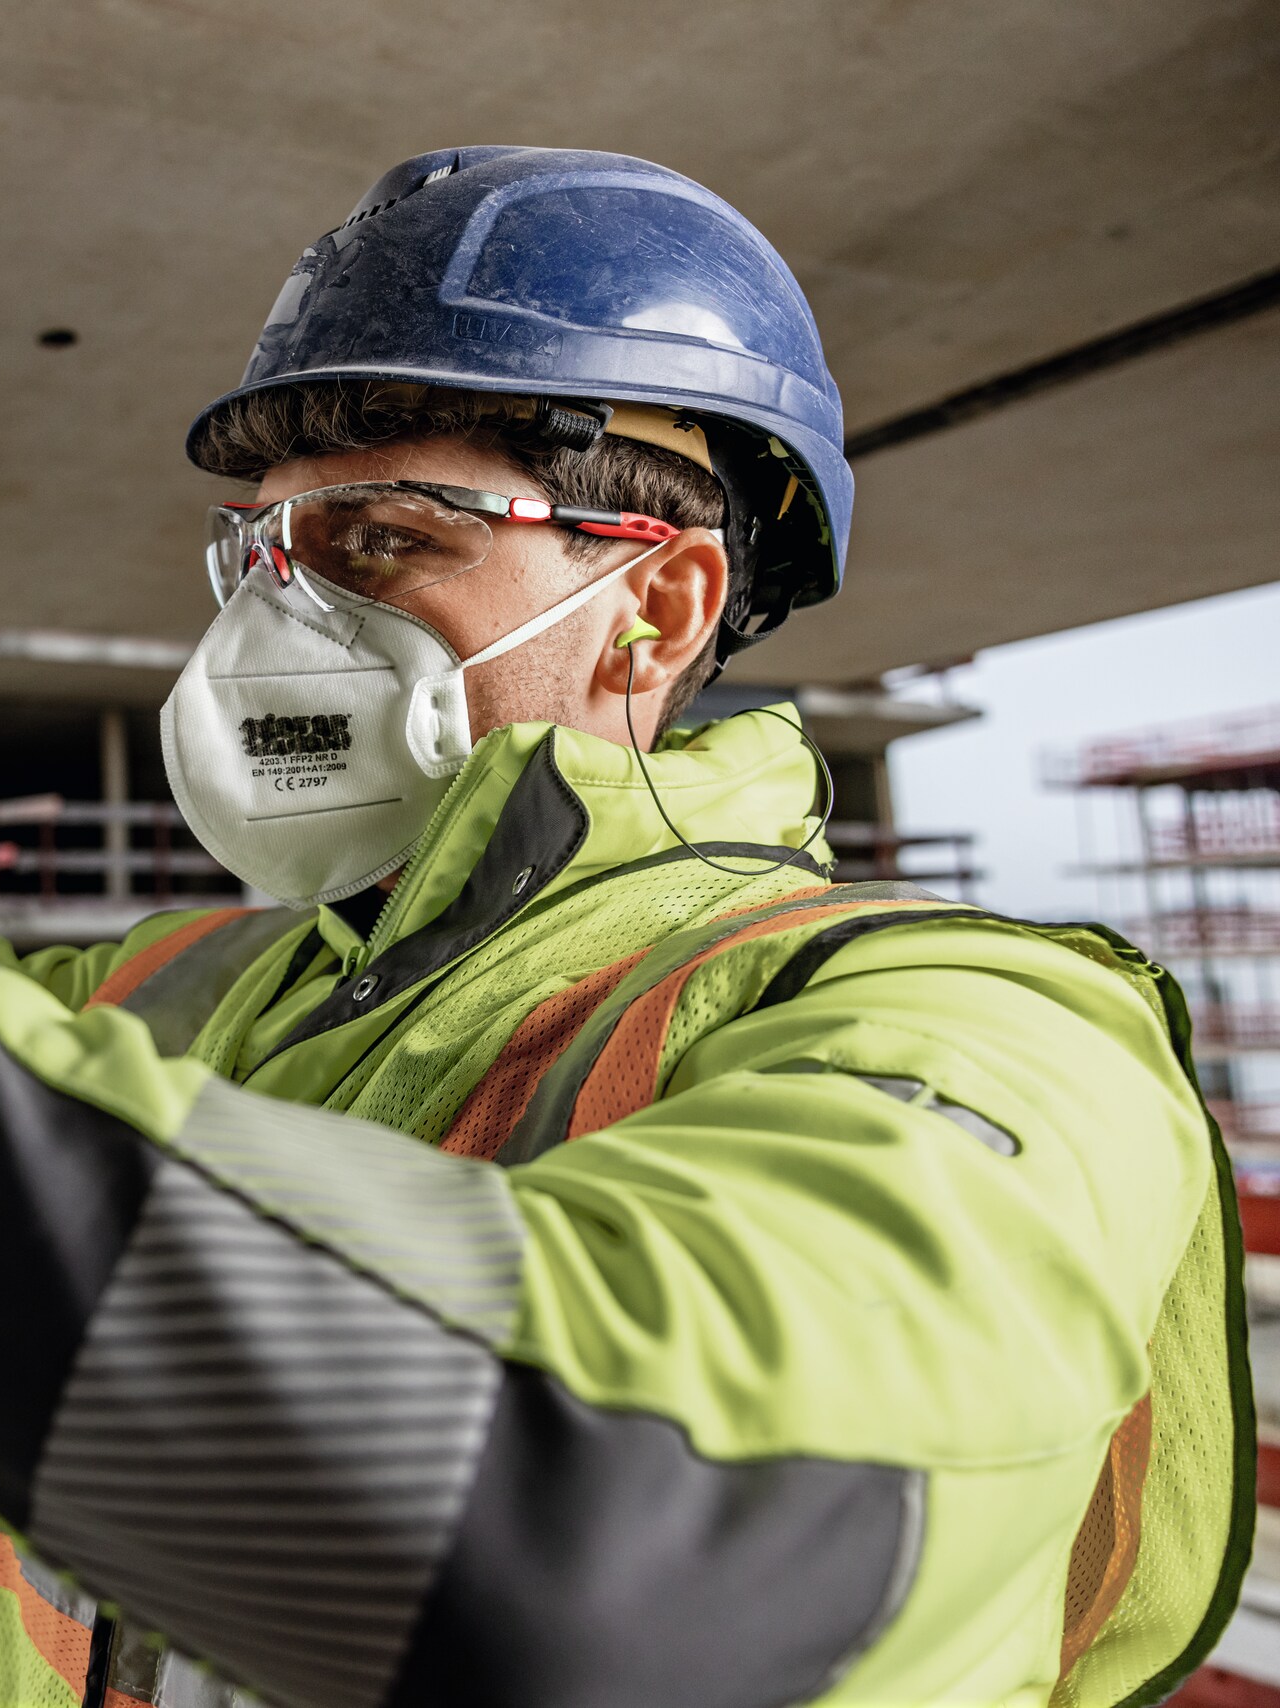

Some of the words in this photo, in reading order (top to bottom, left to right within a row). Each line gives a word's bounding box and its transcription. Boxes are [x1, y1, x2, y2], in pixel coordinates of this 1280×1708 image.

[259, 757, 287, 766] 4203.1
[290, 755, 313, 764] FFP2
[315, 753, 329, 762] NR
[331, 752, 338, 761] D
[252, 768, 265, 777] EN
[298, 776, 328, 788] 2797
